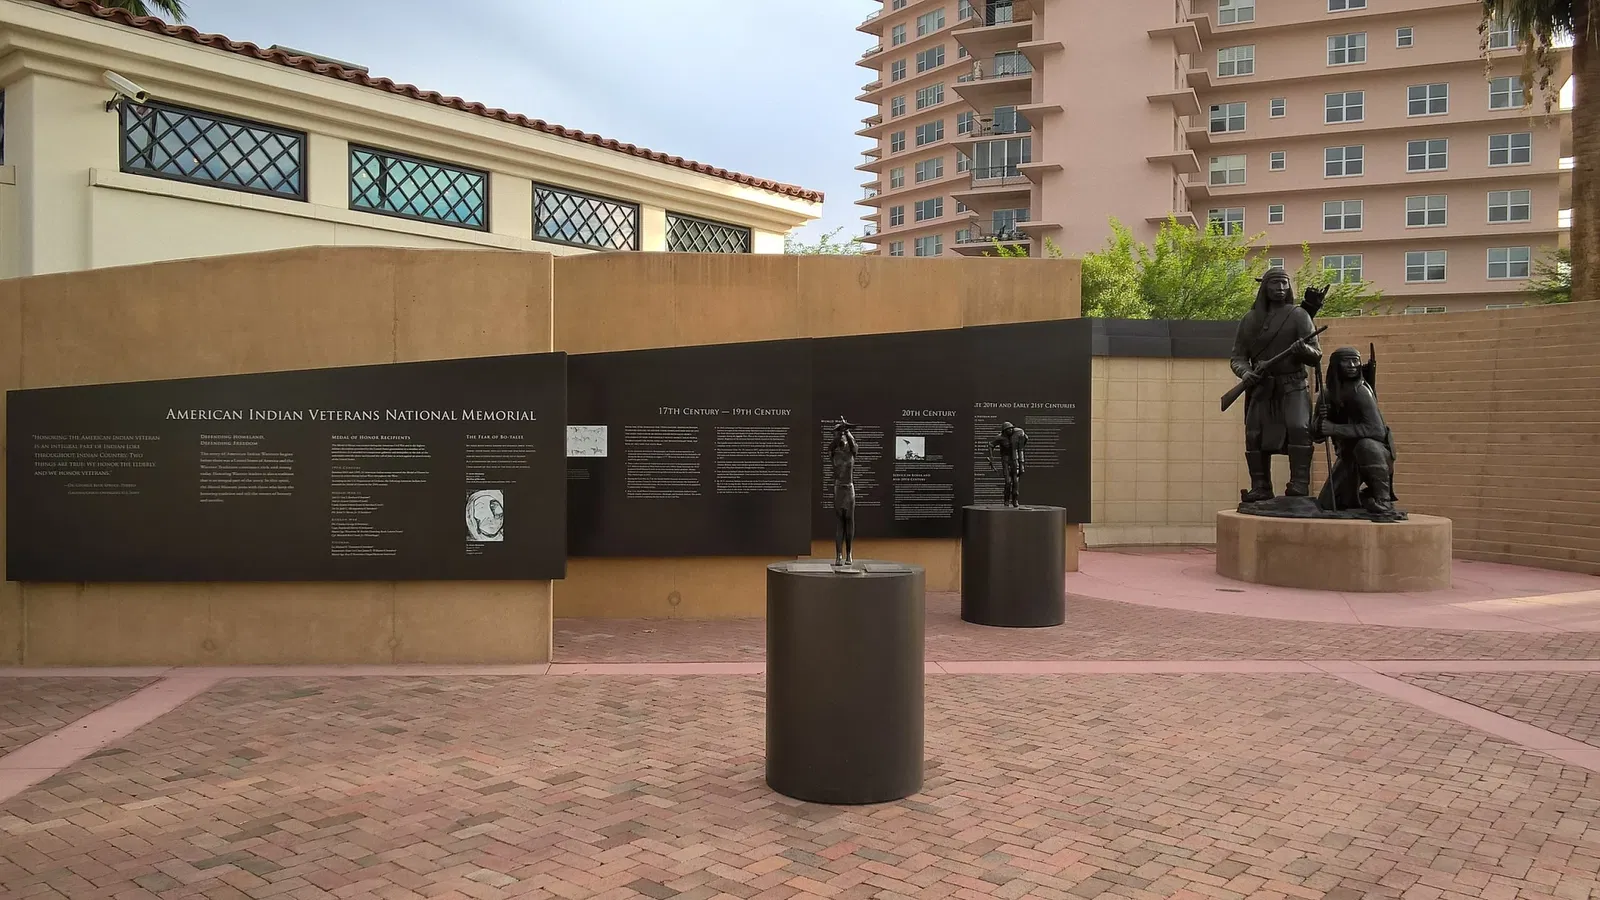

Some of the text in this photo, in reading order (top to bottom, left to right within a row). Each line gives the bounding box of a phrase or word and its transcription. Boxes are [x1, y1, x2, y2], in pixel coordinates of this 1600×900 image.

[166, 409, 536, 420] AMERICAN INDIAN VETERANS NATIONAL MEMORIAL
[658, 407, 680, 415] 17TH
